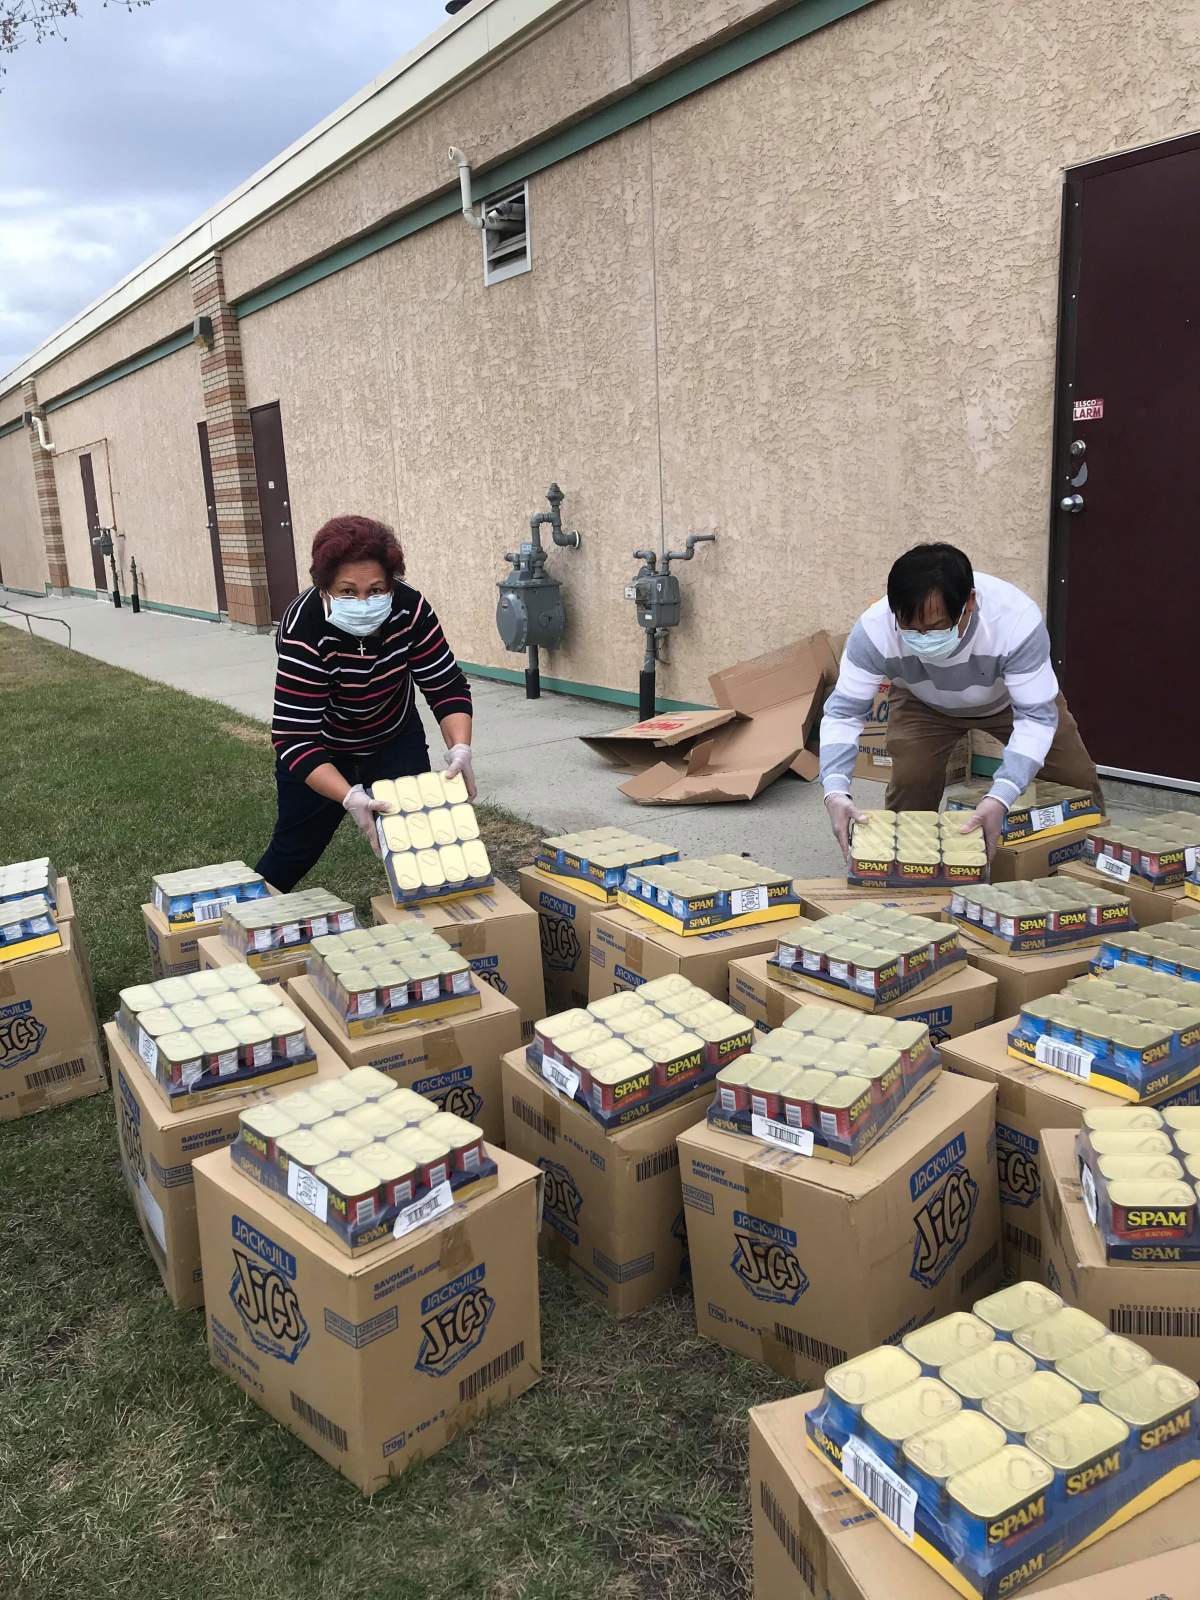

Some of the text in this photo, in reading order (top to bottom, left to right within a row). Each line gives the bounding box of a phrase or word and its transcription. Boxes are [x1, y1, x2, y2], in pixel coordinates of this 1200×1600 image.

[1074, 400, 1096, 408] ELSCO
[1074, 407, 1101, 419] LARM
[1070, 800, 1089, 811] SPAM
[1007, 814, 1028, 825] SPAM
[1007, 830, 1025, 840] SPAM
[537, 861, 551, 871] SPAM
[857, 861, 888, 872] SPAM
[1159, 853, 1184, 865] SPAM
[591, 866, 605, 879] SPAM
[903, 865, 934, 874] SPAM
[950, 867, 981, 876] SPAM
[862, 880, 886, 888] SPAM
[688, 898, 714, 911] SPAM
[1060, 913, 1086, 926] SPAM
[1103, 907, 1129, 919] SPAM
[690, 916, 711, 928] SPAM
[1020, 919, 1046, 930] SPAM
[1021, 940, 1045, 950] SPAM
[909, 951, 928, 968] SPAM
[880, 963, 897, 982] SPAM
[719, 1033, 751, 1054] SPAM
[910, 1036, 929, 1062] SPAM
[1143, 1042, 1170, 1065] SPAM
[667, 1054, 701, 1076] SPAM
[881, 1064, 901, 1091] SPAM
[1146, 1075, 1168, 1094] SPAM
[615, 1075, 649, 1098] SPAM
[620, 1104, 649, 1123] SPAM
[850, 1093, 872, 1120] SPAM
[713, 1118, 738, 1131] SPAM
[181, 1128, 222, 1143] SAVOURY
[242, 1129, 267, 1153] SPAM
[692, 1160, 725, 1176] SAVOURY
[1127, 1211, 1187, 1226] SPAM
[357, 1223, 388, 1246] SPAM
[1131, 1247, 1181, 1259] SPAM
[374, 1264, 414, 1291] SAVOURY
[1141, 1409, 1191, 1450] SPAM
[1066, 1451, 1120, 1495] SPAM
[988, 1496, 1045, 1544] SPAM
[998, 1553, 1044, 1594] SPAM
